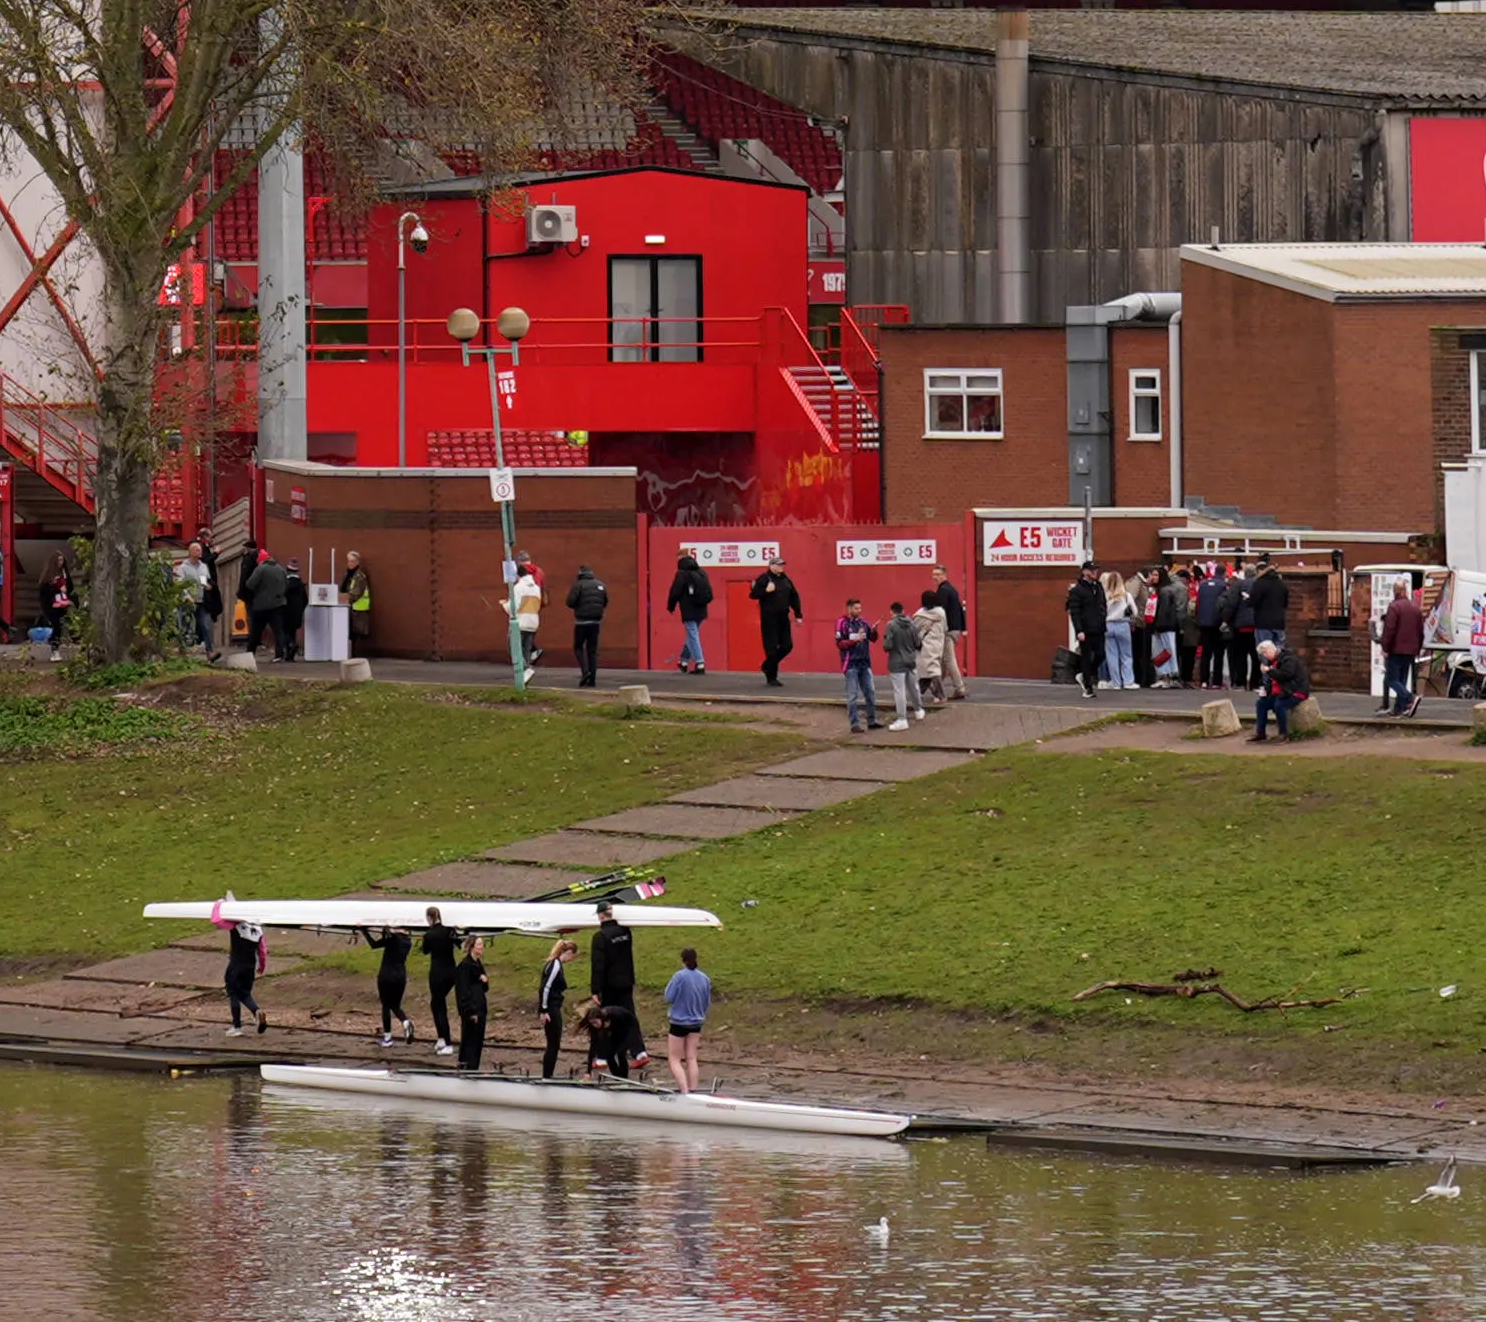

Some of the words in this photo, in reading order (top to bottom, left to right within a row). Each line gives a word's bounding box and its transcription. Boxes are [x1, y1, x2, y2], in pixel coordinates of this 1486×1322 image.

[1020, 527, 1041, 548] E5
[1047, 527, 1077, 537] WICKET
[1052, 538, 1072, 548] GATE
[762, 547, 776, 559] E5
[840, 546, 854, 560] E5
[919, 545, 933, 558] E5
